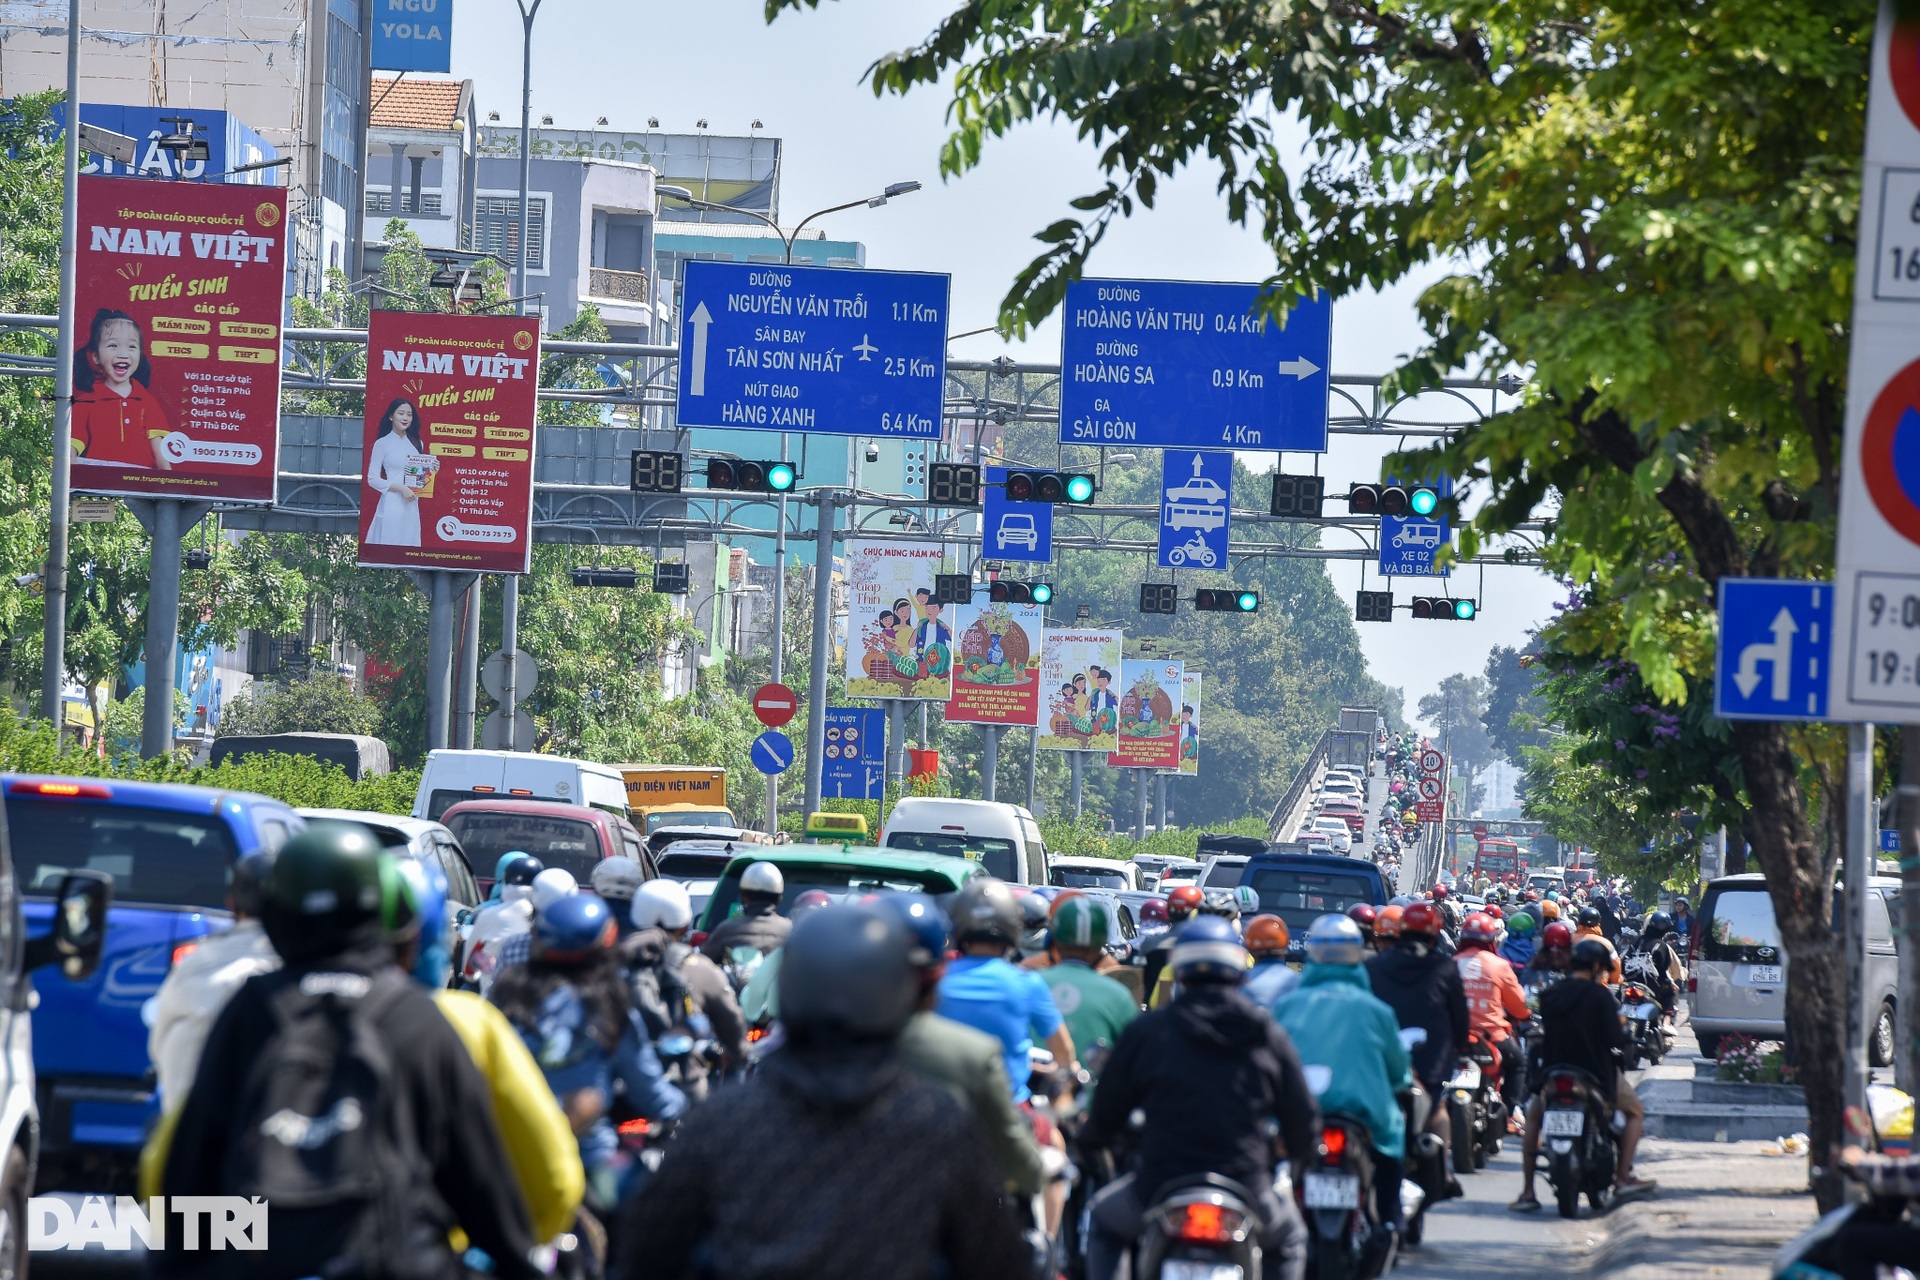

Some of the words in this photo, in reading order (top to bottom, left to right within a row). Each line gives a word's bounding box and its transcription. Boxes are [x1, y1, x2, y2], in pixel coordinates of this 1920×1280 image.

[381, 22, 442, 41] YOLA
[118, 208, 135, 221] TẬP
[136, 210, 162, 221] ĐOÀN
[163, 211, 185, 223] GIÁO
[187, 215, 206, 225] DỤC
[207, 213, 233, 225] QUỐC
[234, 214, 245, 226] TẾ
[90, 225, 182, 257] NAM
[190, 229, 275, 268] VIỆT
[749, 271, 792, 288] ĐƯỜNG
[129, 273, 183, 302] TUYỂN
[187, 276, 228, 297] SINH
[1098, 284, 1141, 302] ĐƯỜNG
[194, 302, 215, 314] CÁC
[219, 302, 240, 315] CẤP
[727, 289, 792, 315] NGUYỄN
[796, 293, 829, 317] VĂN
[833, 292, 868, 319] TRỖI
[892, 302, 908, 322] 1,1
[912, 303, 938, 323] Km
[1076, 304, 1132, 329] HOÀNG
[1135, 307, 1169, 330] VĂN
[1172, 312, 1204, 335] THỤ
[1215, 314, 1237, 333] 0,4
[184, 323, 206, 331] NON
[250, 326, 270, 336] HỌC
[755, 325, 780, 342] SÂN
[783, 329, 806, 344] BAY
[404, 334, 418, 344] TẬP
[418, 335, 439, 346] ĐOÀN
[440, 336, 458, 347] GIÁO
[458, 339, 474, 349] DỤC
[475, 338, 496, 349] QUỐC
[496, 339, 505, 350] TẾ
[1096, 339, 1138, 357] ĐƯỜNG
[167, 346, 192, 355] THCS
[234, 350, 260, 359] THPT
[382, 349, 455, 375] NAM
[461, 352, 529, 384] VIỆT
[726, 345, 758, 369] TÂN
[762, 351, 795, 370] SƠN
[799, 347, 844, 373] NHẤT
[884, 357, 906, 377] 2,5
[909, 358, 935, 378] Km
[184, 372, 199, 381] Với
[200, 373, 211, 381] 10
[225, 374, 236, 383] sở
[1075, 360, 1130, 384] HOÀNG
[1134, 365, 1155, 385] SA
[1212, 369, 1234, 389] 0,9
[1238, 369, 1264, 388] Km
[191, 384, 215, 395] Quận
[216, 385, 232, 394] Tân
[233, 386, 251, 396] Phú
[744, 380, 769, 397] NÚT
[771, 384, 799, 399] GIAO
[191, 396, 214, 407] Quận
[215, 398, 226, 406] 12
[418, 385, 460, 409] TUYỂN
[462, 387, 495, 403] SINH
[1094, 398, 1111, 412] GA
[190, 408, 213, 419] Quận
[215, 409, 228, 418] Gò
[229, 408, 246, 421] Vấp
[464, 410, 481, 421] CÁC
[483, 411, 501, 423] CẤP
[722, 400, 767, 424] HÀNG
[770, 406, 815, 428] XANH
[881, 413, 903, 433] 6,4
[907, 414, 933, 433] Km
[190, 420, 202, 428] TP
[203, 420, 219, 430] Thủ
[220, 420, 240, 431] Đức
[455, 427, 473, 435] NON
[1073, 416, 1100, 439] SÀI
[1103, 416, 1136, 440] GÒN
[1222, 425, 1232, 443] 4
[1235, 425, 1261, 444] Km
[508, 430, 524, 438] HỌC
[193, 448, 216, 457] 1900
[218, 449, 230, 457] 75
[232, 450, 243, 458] 75
[245, 450, 257, 459] 75
[442, 446, 462, 454] THCS
[495, 450, 516, 458] THPT
[455, 467, 467, 476] Với
[488, 468, 497, 477] sở
[122, 474, 219, 487] www.truongnamviet.edu.vn
[460, 477, 480, 486] Quận
[481, 478, 494, 486] Tân
[494, 479, 508, 487] Phú
[460, 488, 479, 497] Quận
[480, 488, 489, 496] 12
[459, 497, 479, 506] Quận
[479, 498, 490, 506] Gò
[490, 497, 505, 508] Vấp
[459, 507, 469, 515] TP
[469, 506, 483, 516] Thủ
[483, 507, 499, 517] Đức
[461, 529, 480, 537] 1900
[405, 551, 481, 561] www.truongnamviet.edu.vn
[863, 546, 883, 557] CHÚC
[884, 546, 908, 558] MỪNG
[909, 547, 928, 558] NĂM
[1401, 551, 1416, 561] XE
[1417, 551, 1430, 562] 02
[1384, 561, 1399, 573] VÀ
[1401, 564, 1413, 573] 03
[1048, 634, 1064, 642] CHÚC
[839, 714, 857, 725] VƯỢT
[643, 779, 665, 793] ĐIỆN
[668, 778, 687, 792] VIỆT
[689, 780, 711, 790] NAM
